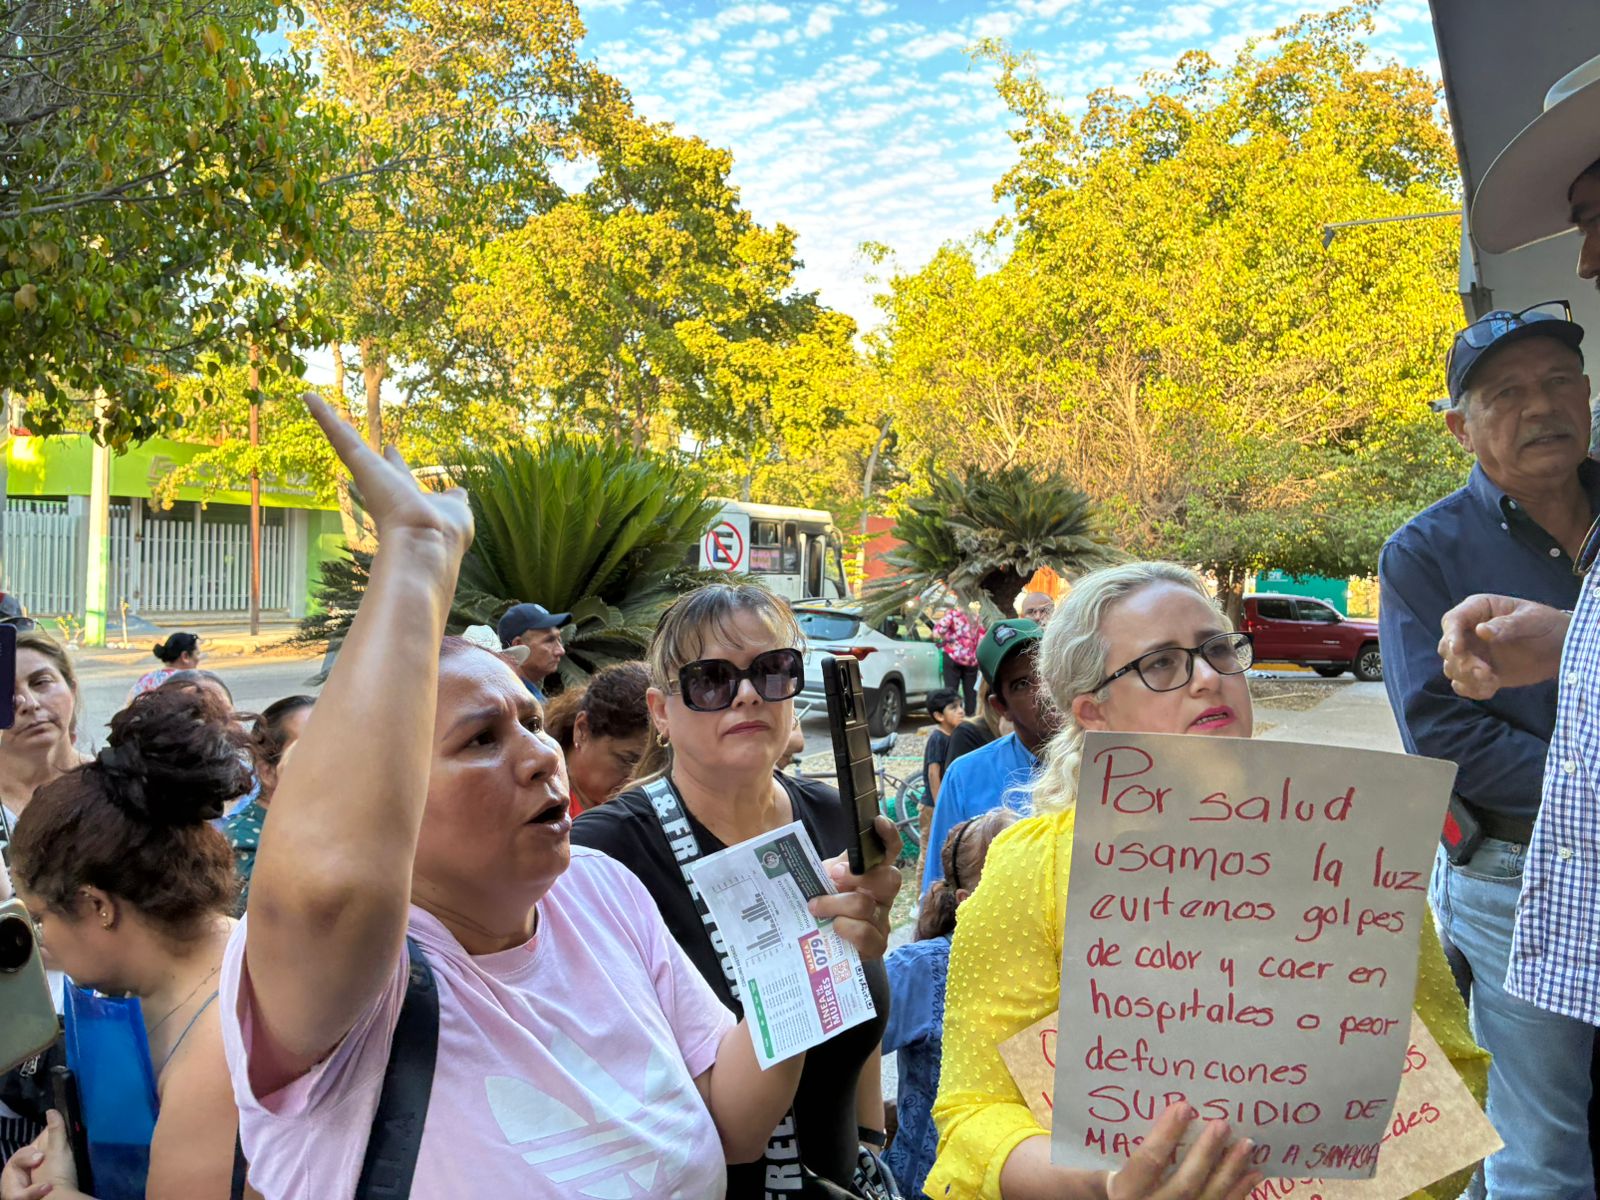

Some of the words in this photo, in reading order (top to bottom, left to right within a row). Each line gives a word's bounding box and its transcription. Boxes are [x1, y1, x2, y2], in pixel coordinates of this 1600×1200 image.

[1094, 746, 1172, 814] Por
[1189, 777, 1355, 823] salud
[1095, 842, 1271, 881] usamos
[1312, 842, 1343, 887] la
[1373, 846, 1426, 891] luz
[1295, 898, 1405, 943] golpes
[811, 938, 828, 966] 079
[1086, 937, 1122, 968] de
[1220, 957, 1234, 987] y
[1258, 956, 1334, 981] caer
[1349, 967, 1387, 988] en
[823, 977, 840, 1025] MUJERES
[1091, 978, 1275, 1034] hospitales
[1296, 1013, 1321, 1030] o
[1339, 1016, 1399, 1045] peor
[1085, 1035, 1307, 1085] defunciones
[1345, 1099, 1388, 1120] DE
